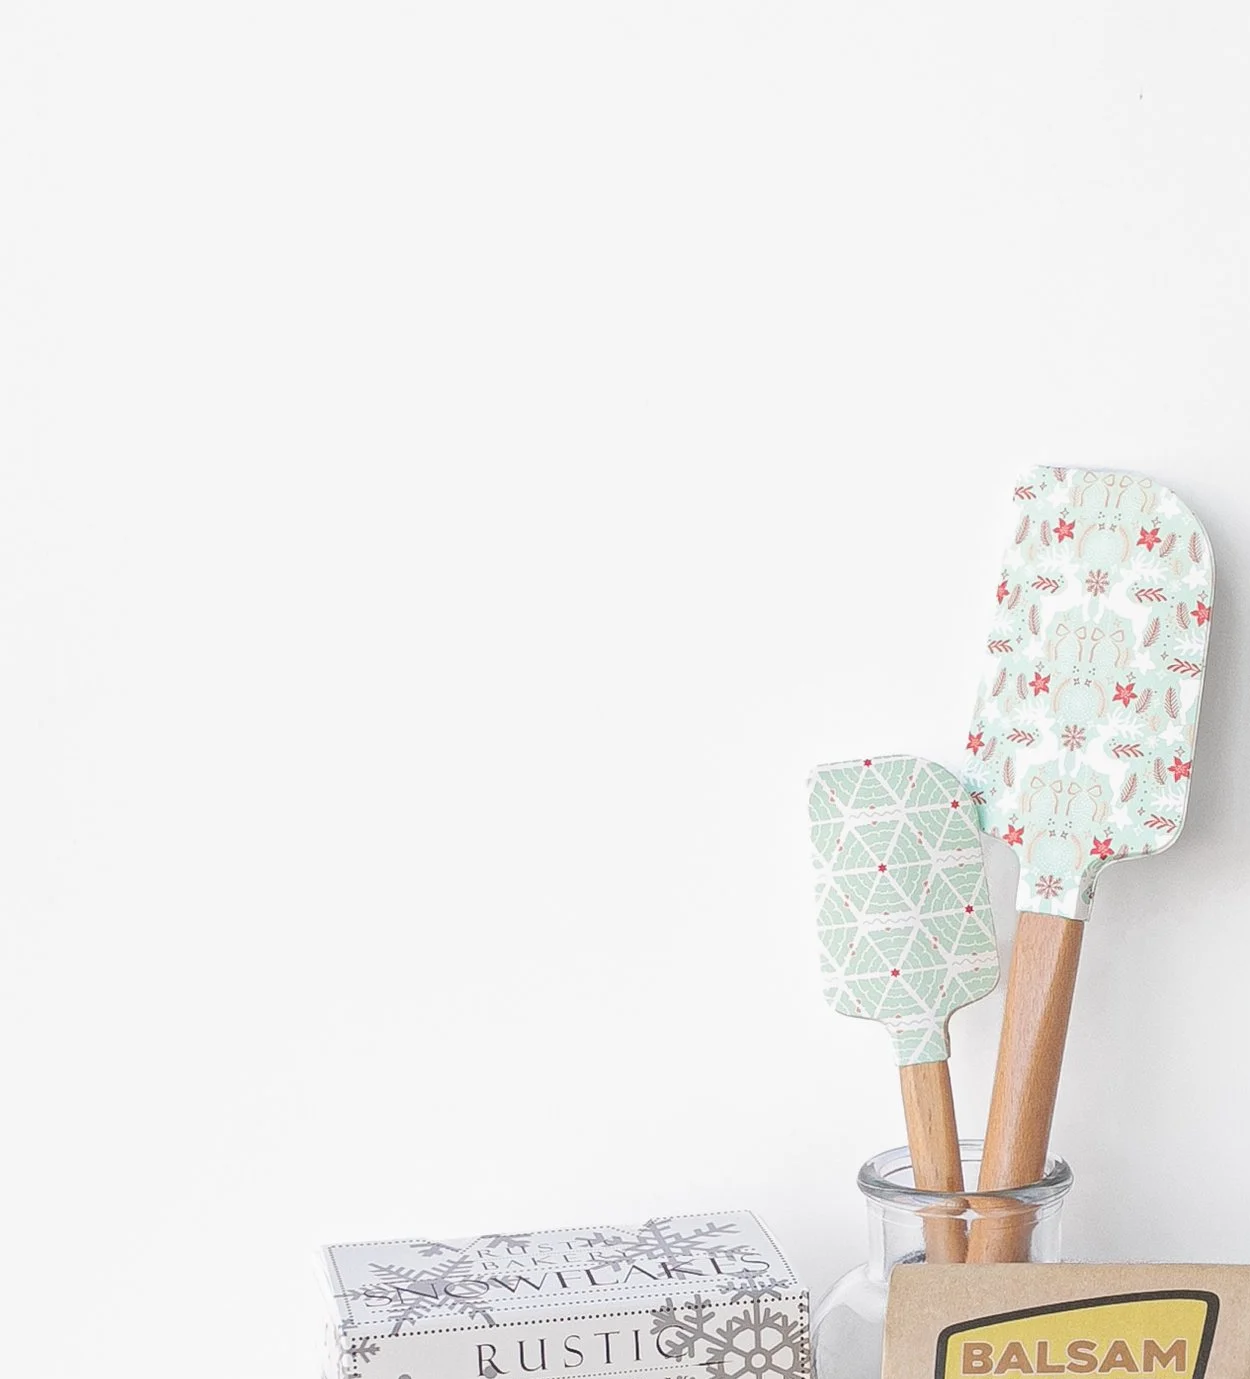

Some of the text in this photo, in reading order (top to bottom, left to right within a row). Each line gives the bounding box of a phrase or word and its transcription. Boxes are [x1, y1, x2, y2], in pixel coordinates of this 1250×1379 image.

[477, 1238, 621, 1259] RUSTIC
[482, 1250, 628, 1270] BAKERY
[363, 1253, 772, 1308] SNOWFLAKES
[477, 1324, 690, 1377] RUSTIC
[961, 1338, 1187, 1376] BALSAM
